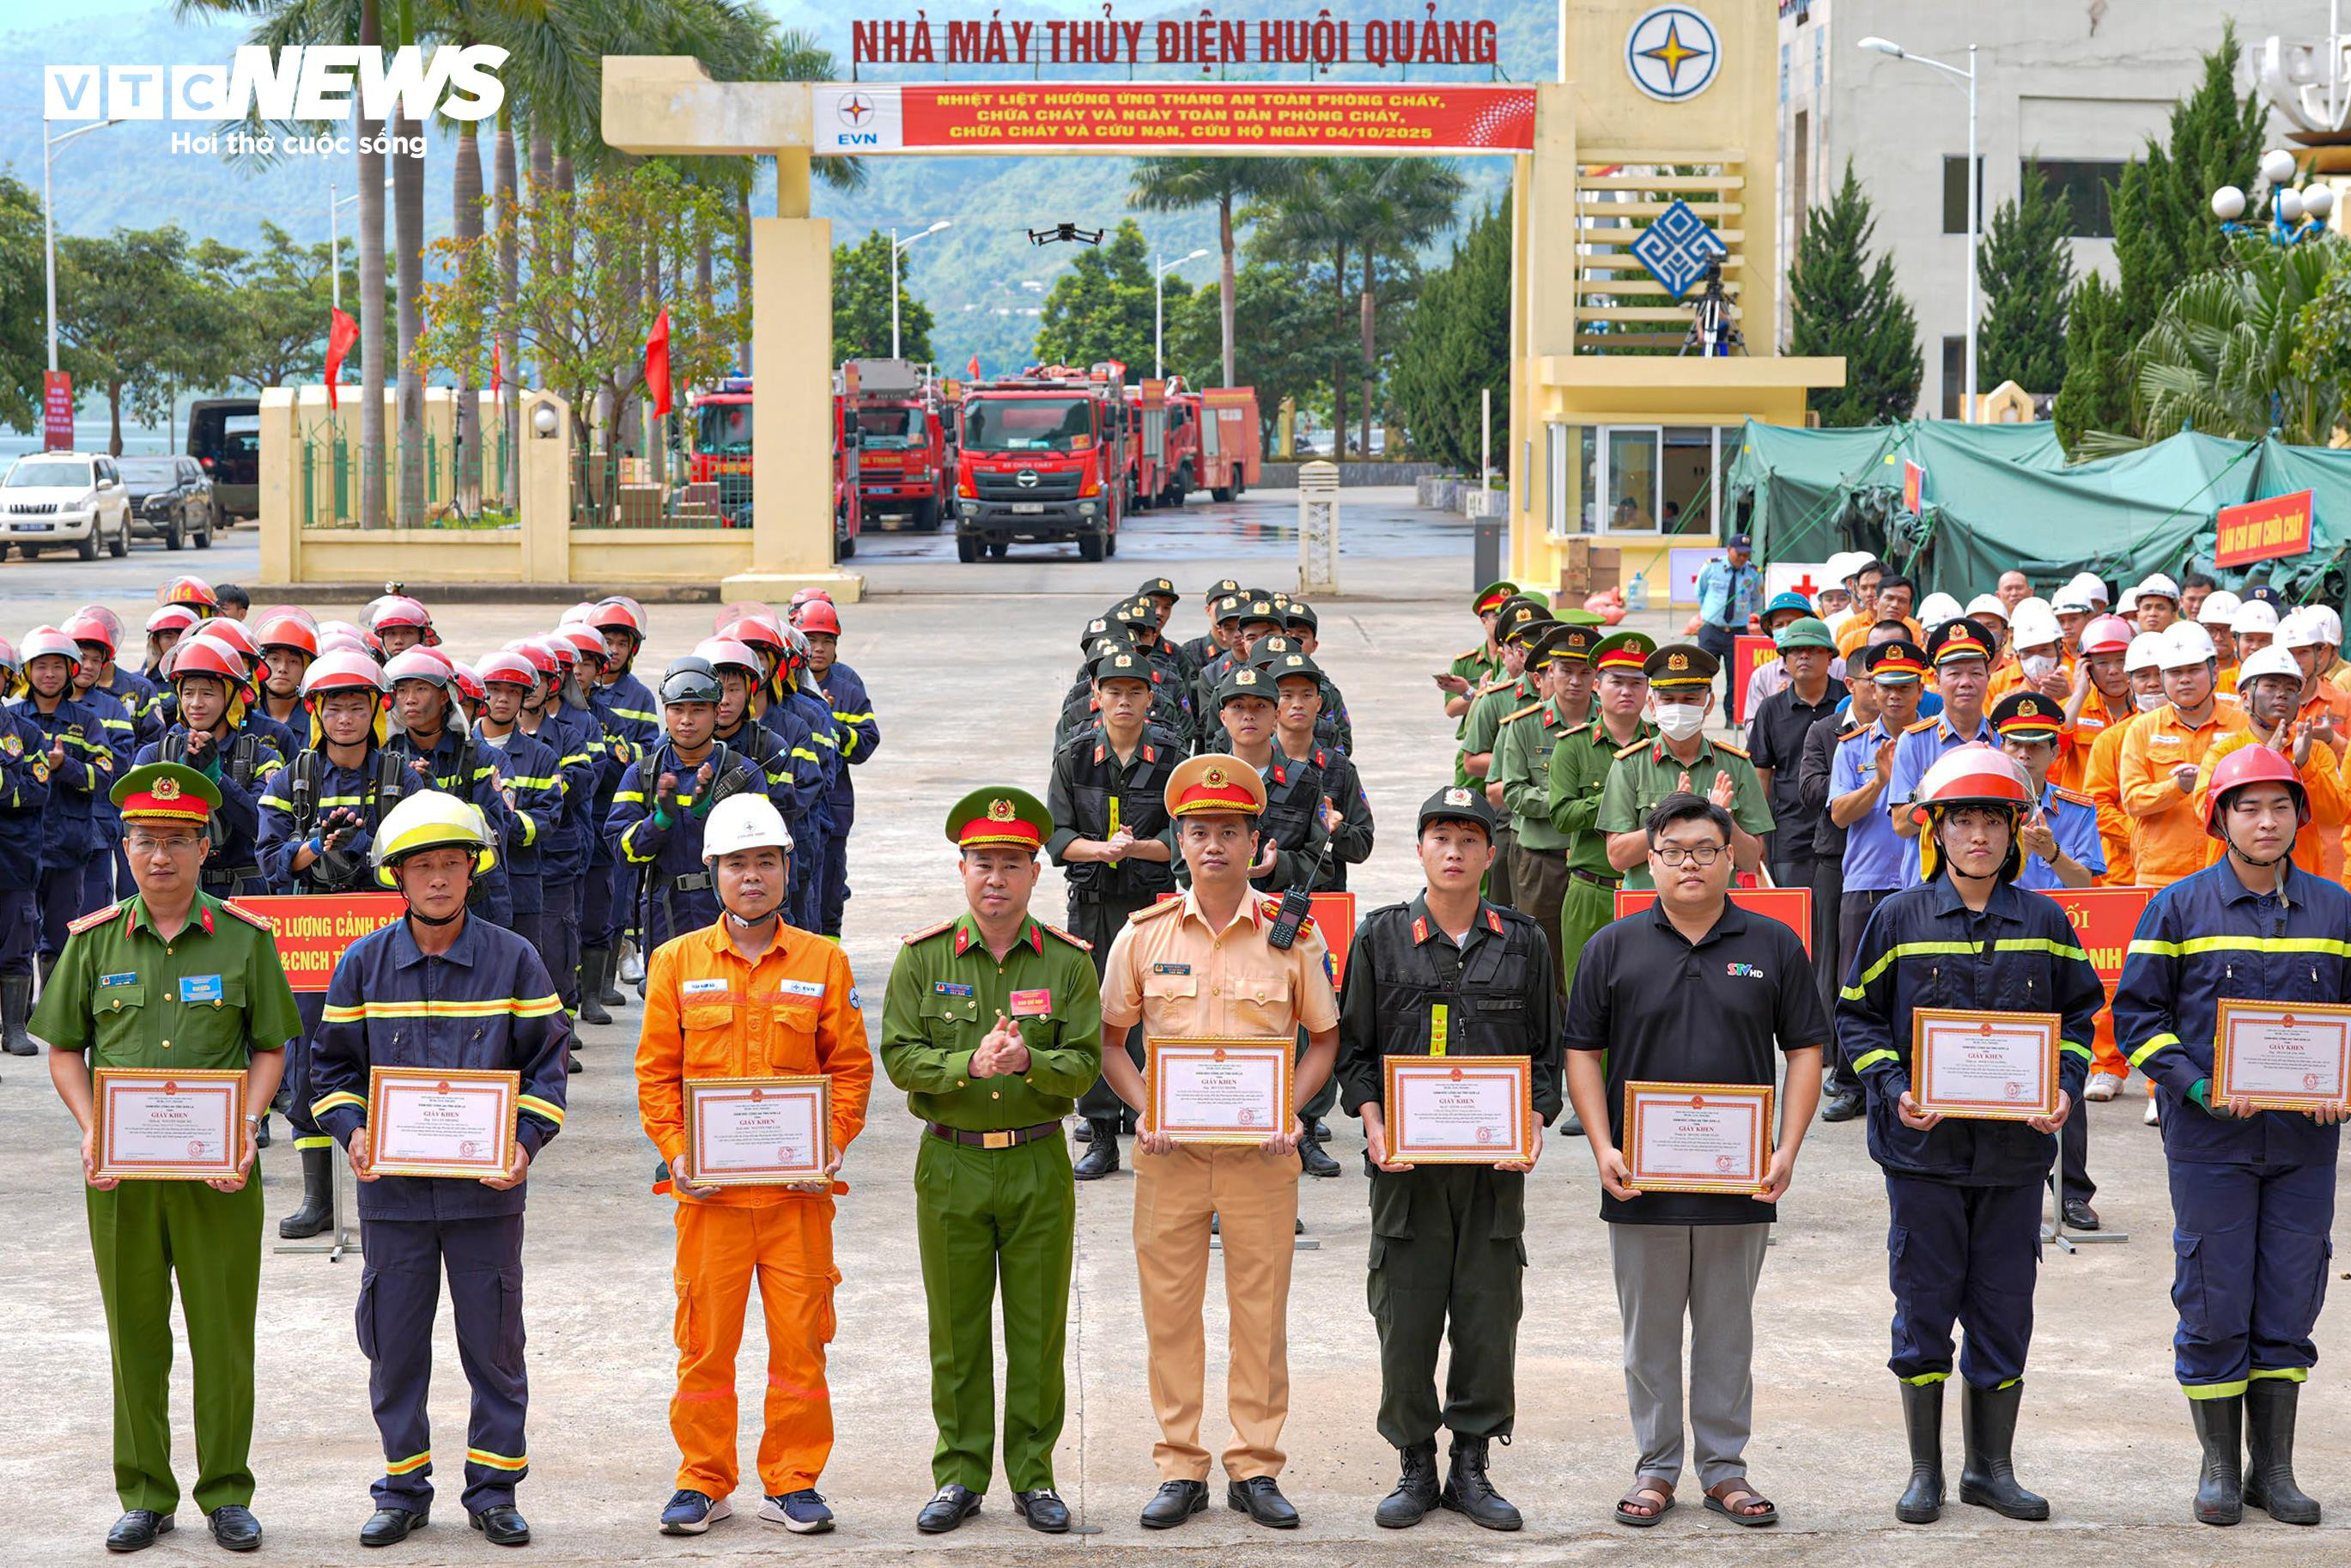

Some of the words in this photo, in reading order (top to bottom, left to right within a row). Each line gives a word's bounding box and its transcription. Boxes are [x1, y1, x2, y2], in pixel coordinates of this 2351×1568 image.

[853, 9, 933, 63] NHÀ
[949, 9, 1033, 63] MÁY
[1047, 3, 1143, 63] THỦY
[1157, 9, 1246, 72] ĐIỆN
[1261, 9, 1349, 73] HUỘI
[1365, 3, 1497, 68] QUẢNG
[937, 93, 993, 107] NHIỆT
[999, 92, 1038, 106] LIỆT
[1116, 91, 1156, 105] ỨNG
[1161, 92, 1224, 105] THÁNG
[1230, 94, 1256, 105] AN
[1261, 93, 1312, 106] TOÀN
[1317, 94, 1383, 106] PHÒNG
[1389, 94, 1446, 108] CHÁY,
[976, 107, 1030, 121] CHỮA
[1035, 108, 1086, 121] CHÁY
[1091, 108, 1116, 120] VÀ
[1122, 108, 1172, 121] NGÀY
[1178, 108, 1228, 121] TOÀN
[1233, 108, 1272, 121] DÂN
[1278, 109, 1343, 122] PHÒNG
[1349, 109, 1406, 124] CHÁY,
[837, 132, 878, 146] EVN
[950, 124, 1002, 137] CHỮA
[1008, 125, 1059, 137] CHÁY
[1064, 124, 1090, 137] VÀ
[1095, 124, 1135, 137] CỨU
[1141, 125, 1185, 138] NẠN,
[1191, 124, 1231, 137] CỨU
[1237, 124, 1264, 139] HỘ
[1270, 124, 1320, 137] NGÀY
[1325, 126, 1432, 139] 04/10/2025
[285, 915, 331, 942] LƯỢNG
[336, 911, 374, 938] CẢNH
